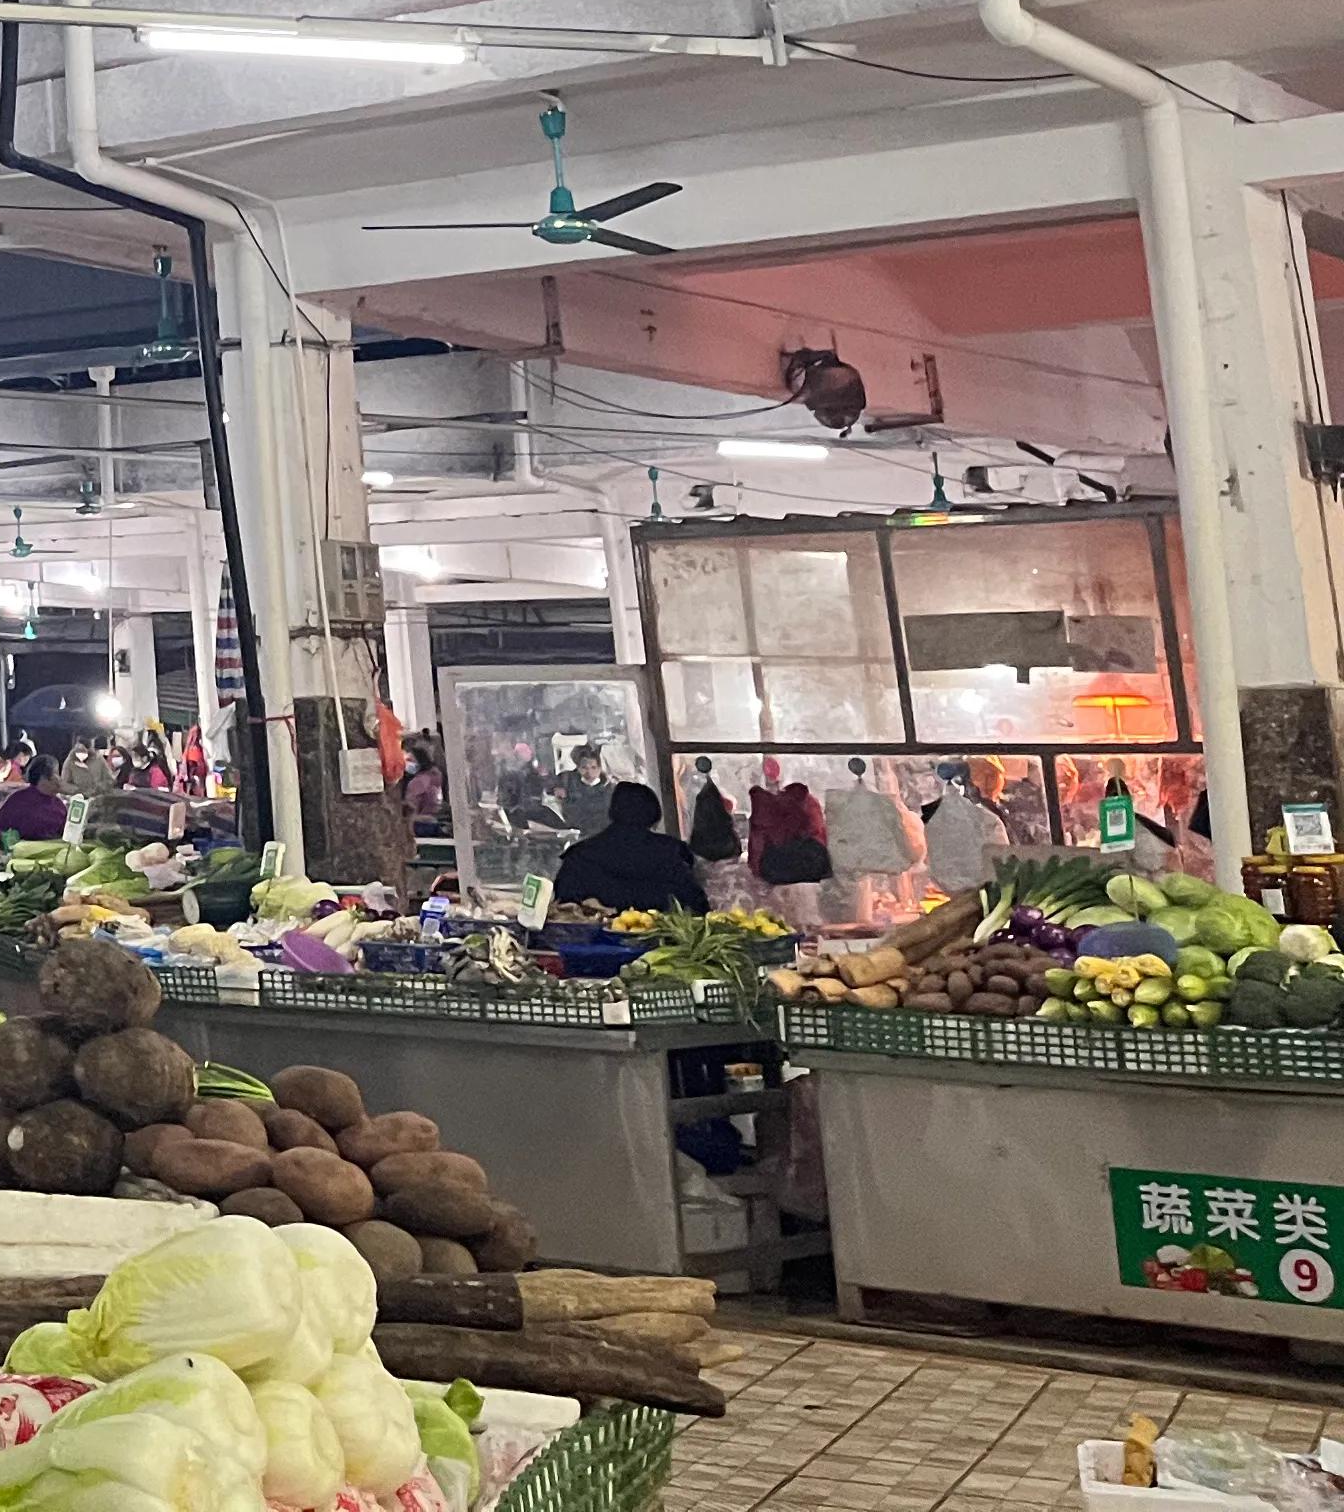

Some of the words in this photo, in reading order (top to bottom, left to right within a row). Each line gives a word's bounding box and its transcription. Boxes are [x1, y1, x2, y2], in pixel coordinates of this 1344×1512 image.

[1138, 1182, 1331, 1250] 蔬菜类
[1294, 1259, 1318, 1292] 9
